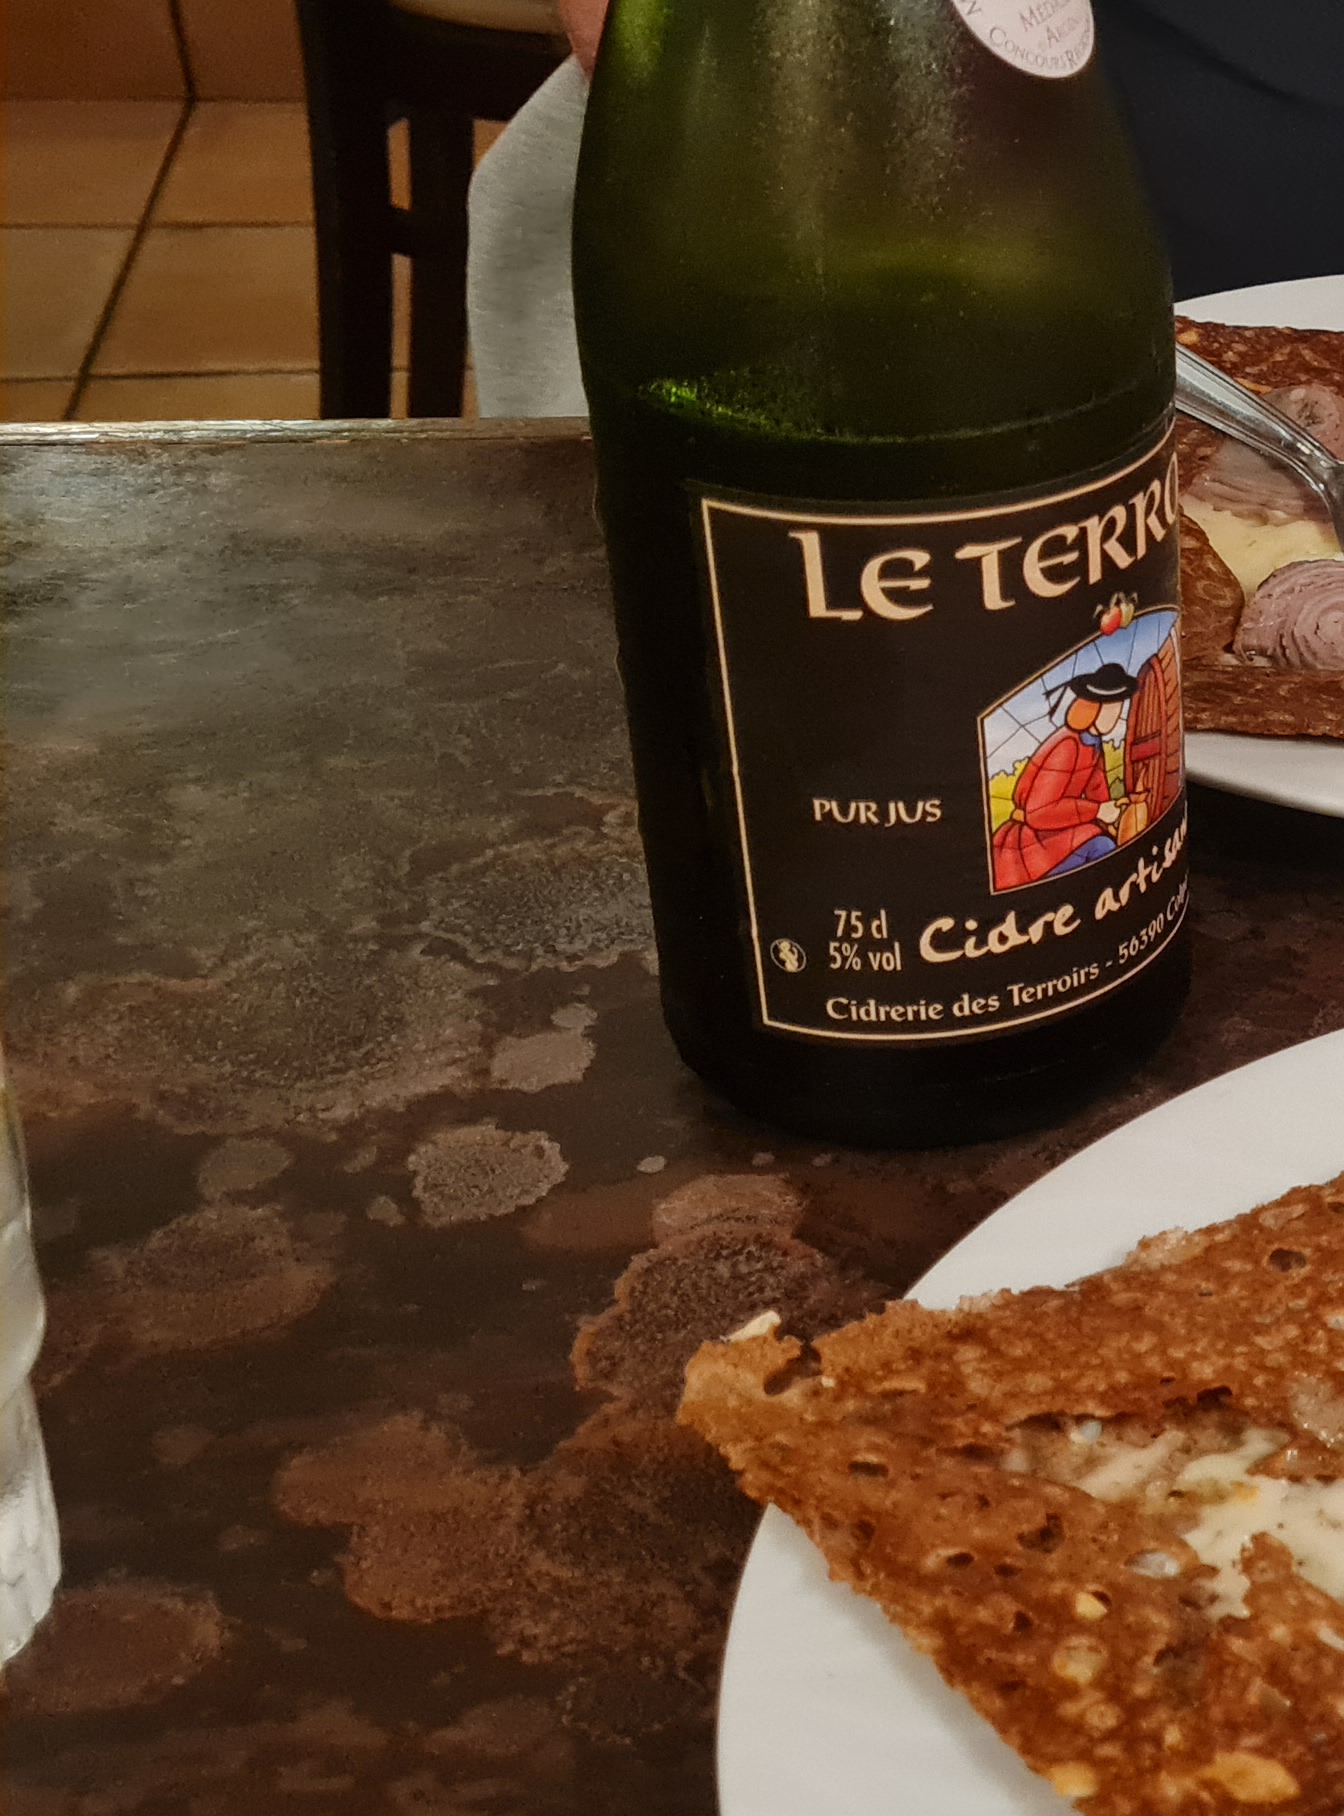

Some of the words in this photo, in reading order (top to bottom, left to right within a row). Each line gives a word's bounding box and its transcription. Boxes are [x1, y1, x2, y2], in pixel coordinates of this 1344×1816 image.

[789, 530, 933, 621] LE
[813, 799, 879, 824] PUR
[885, 799, 942, 827] JUS
[833, 909, 864, 939] 75
[871, 908, 888, 939] cl
[919, 902, 1081, 963] Cidre
[825, 996, 944, 1022] Cidrerie
[952, 993, 1000, 1017] des
[1006, 961, 1100, 1008] Terroirs
[1118, 912, 1165, 964] 56390
[828, 941, 861, 971] 5%
[867, 941, 902, 971] vol
